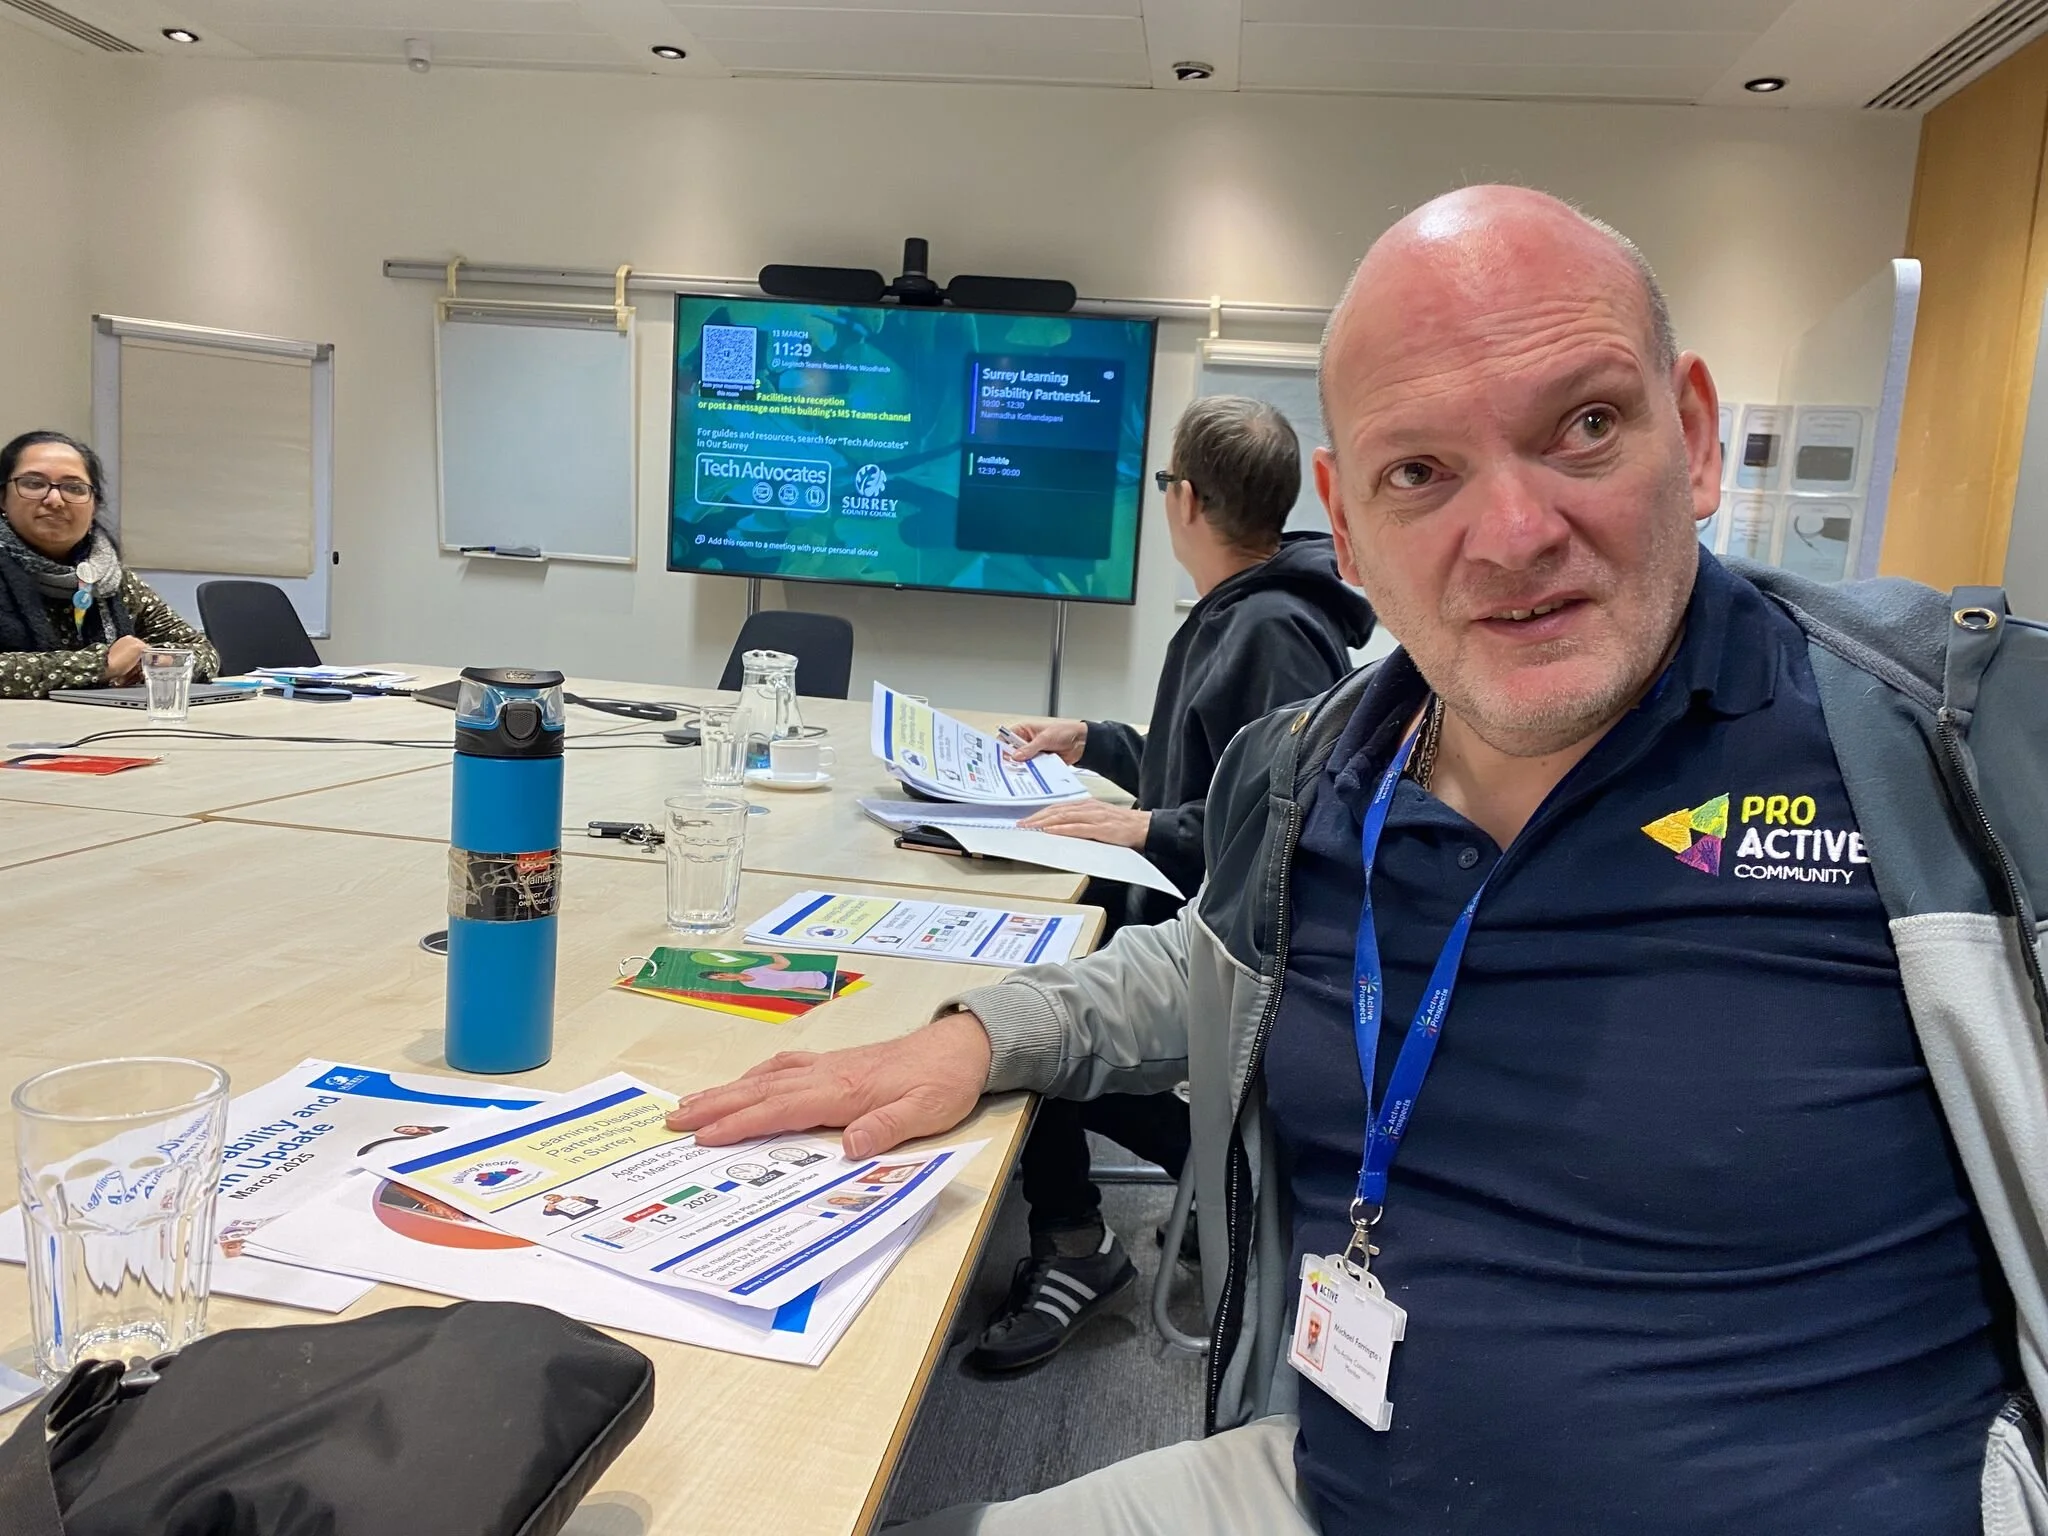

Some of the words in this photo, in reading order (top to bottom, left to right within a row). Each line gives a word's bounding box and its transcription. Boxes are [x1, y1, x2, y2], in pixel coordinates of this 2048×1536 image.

[781, 330, 809, 339] MARCH
[773, 341, 812, 357] 11:29
[982, 368, 1019, 384] Surrey
[1020, 370, 1069, 386] Learning
[756, 392, 792, 404] Facilities
[793, 395, 805, 404] via
[806, 396, 845, 407] reception
[981, 386, 1033, 401] Disability
[1006, 401, 1025, 409] 12:30
[697, 401, 708, 409] or
[708, 402, 726, 411] post
[733, 403, 768, 415] message
[780, 405, 796, 415] this
[837, 409, 850, 418] MS
[850, 410, 878, 420] Teams
[878, 412, 911, 422] channel
[697, 428, 710, 438] For
[711, 429, 738, 440] guides
[739, 430, 755, 440] and
[755, 432, 797, 443] resources,
[797, 434, 824, 444] search
[824, 435, 838, 445] for
[697, 438, 705, 447] in
[706, 439, 721, 449] Our
[721, 440, 749, 451] Surrey
[701, 458, 740, 479] Tech
[741, 461, 827, 484] Advocates
[842, 496, 898, 511] SURREY
[708, 537, 722, 546] Add
[723, 538, 735, 547] this
[736, 540, 754, 548] room
[754, 540, 763, 548] to
[769, 542, 796, 552] meeting
[797, 543, 811, 552] with
[811, 545, 827, 554] your
[828, 546, 857, 556] personal
[857, 548, 879, 557] device
[1741, 795, 1816, 826] PRO
[1736, 827, 1871, 864] ACTIVE
[1734, 864, 1854, 885] COMMUNITY
[1359, 985, 1367, 1025] Prospects
[1427, 989, 1441, 1016] Active
[1430, 988, 1449, 1028] Prospects
[292, 1094, 341, 1118] and
[1388, 1100, 1402, 1126] Active
[1392, 1099, 1412, 1136] Prospects
[527, 1125, 596, 1151] Learning
[594, 1102, 660, 1127] Disability
[236, 1122, 335, 1170] Update
[545, 1125, 633, 1158] Partnership
[564, 1155, 585, 1164] in
[583, 1136, 637, 1157] Surrey
[228, 1172, 282, 1201] March
[276, 1151, 316, 1173] 2025
[477, 1160, 519, 1169] People
[611, 1156, 658, 1179] Agenda
[656, 1150, 675, 1159] for
[627, 1174, 646, 1183] 13
[642, 1159, 682, 1176] March
[679, 1147, 711, 1161] 2025
[683, 1192, 718, 1210] 2025
[649, 1213, 677, 1225] 13
[678, 1231, 696, 1240] The
[696, 1218, 725, 1233] meeting
[723, 1219, 739, 1228] and
[687, 1264, 710, 1274] The
[709, 1246, 744, 1265] meeting
[743, 1238, 760, 1248] will
[758, 1232, 773, 1240] be
[702, 1259, 741, 1278] Chaired
[739, 1253, 752, 1261] by
[750, 1240, 775, 1254] Anna
[717, 1271, 737, 1281] and
[733, 1254, 769, 1272] Debbie
[1320, 1284, 1339, 1304] ACTIVE
[1334, 1323, 1354, 1344] Michael
